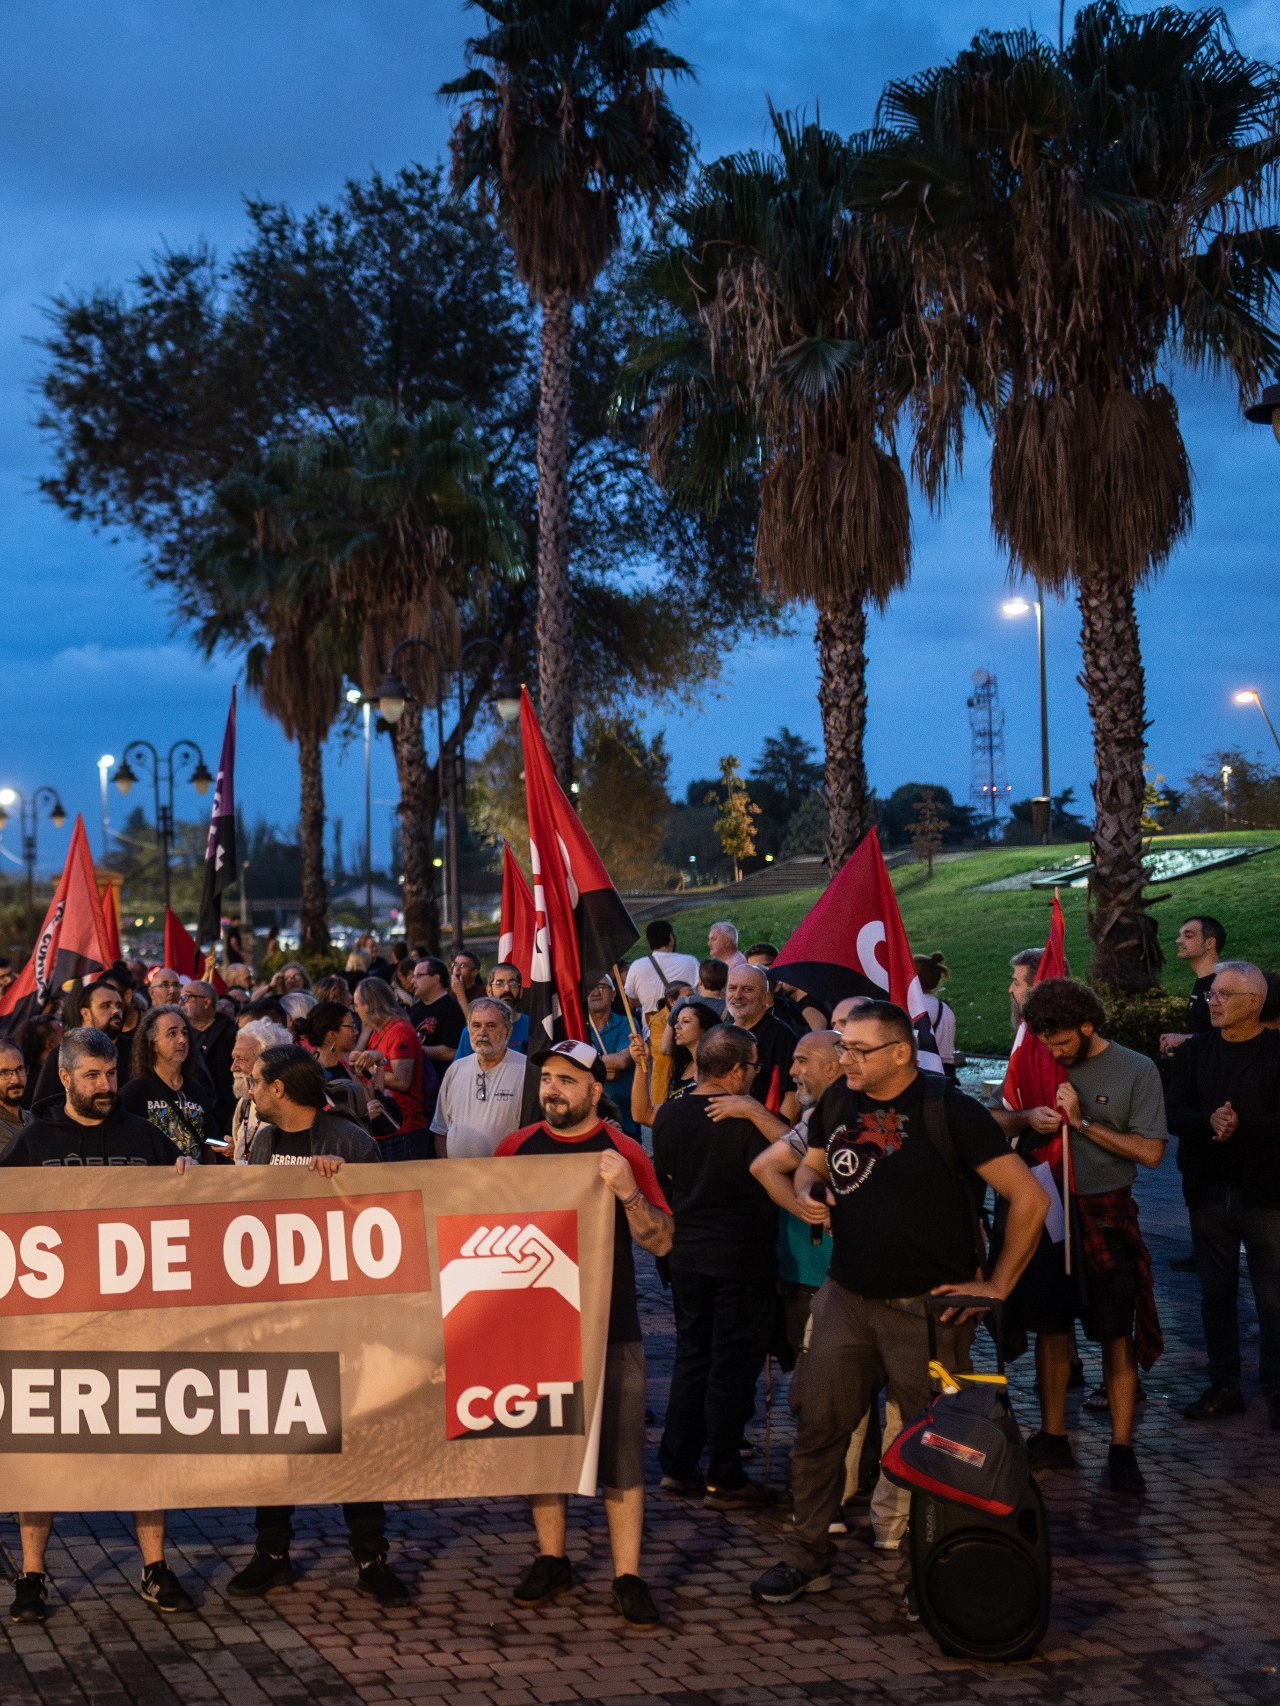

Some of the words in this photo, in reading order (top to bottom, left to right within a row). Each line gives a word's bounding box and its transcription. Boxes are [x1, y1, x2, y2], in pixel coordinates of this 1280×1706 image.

[147, 1100, 168, 1110] BAD
[98, 1218, 192, 1295] DE
[223, 1206, 403, 1288] ODIO
[456, 1381, 575, 1432] CGT
